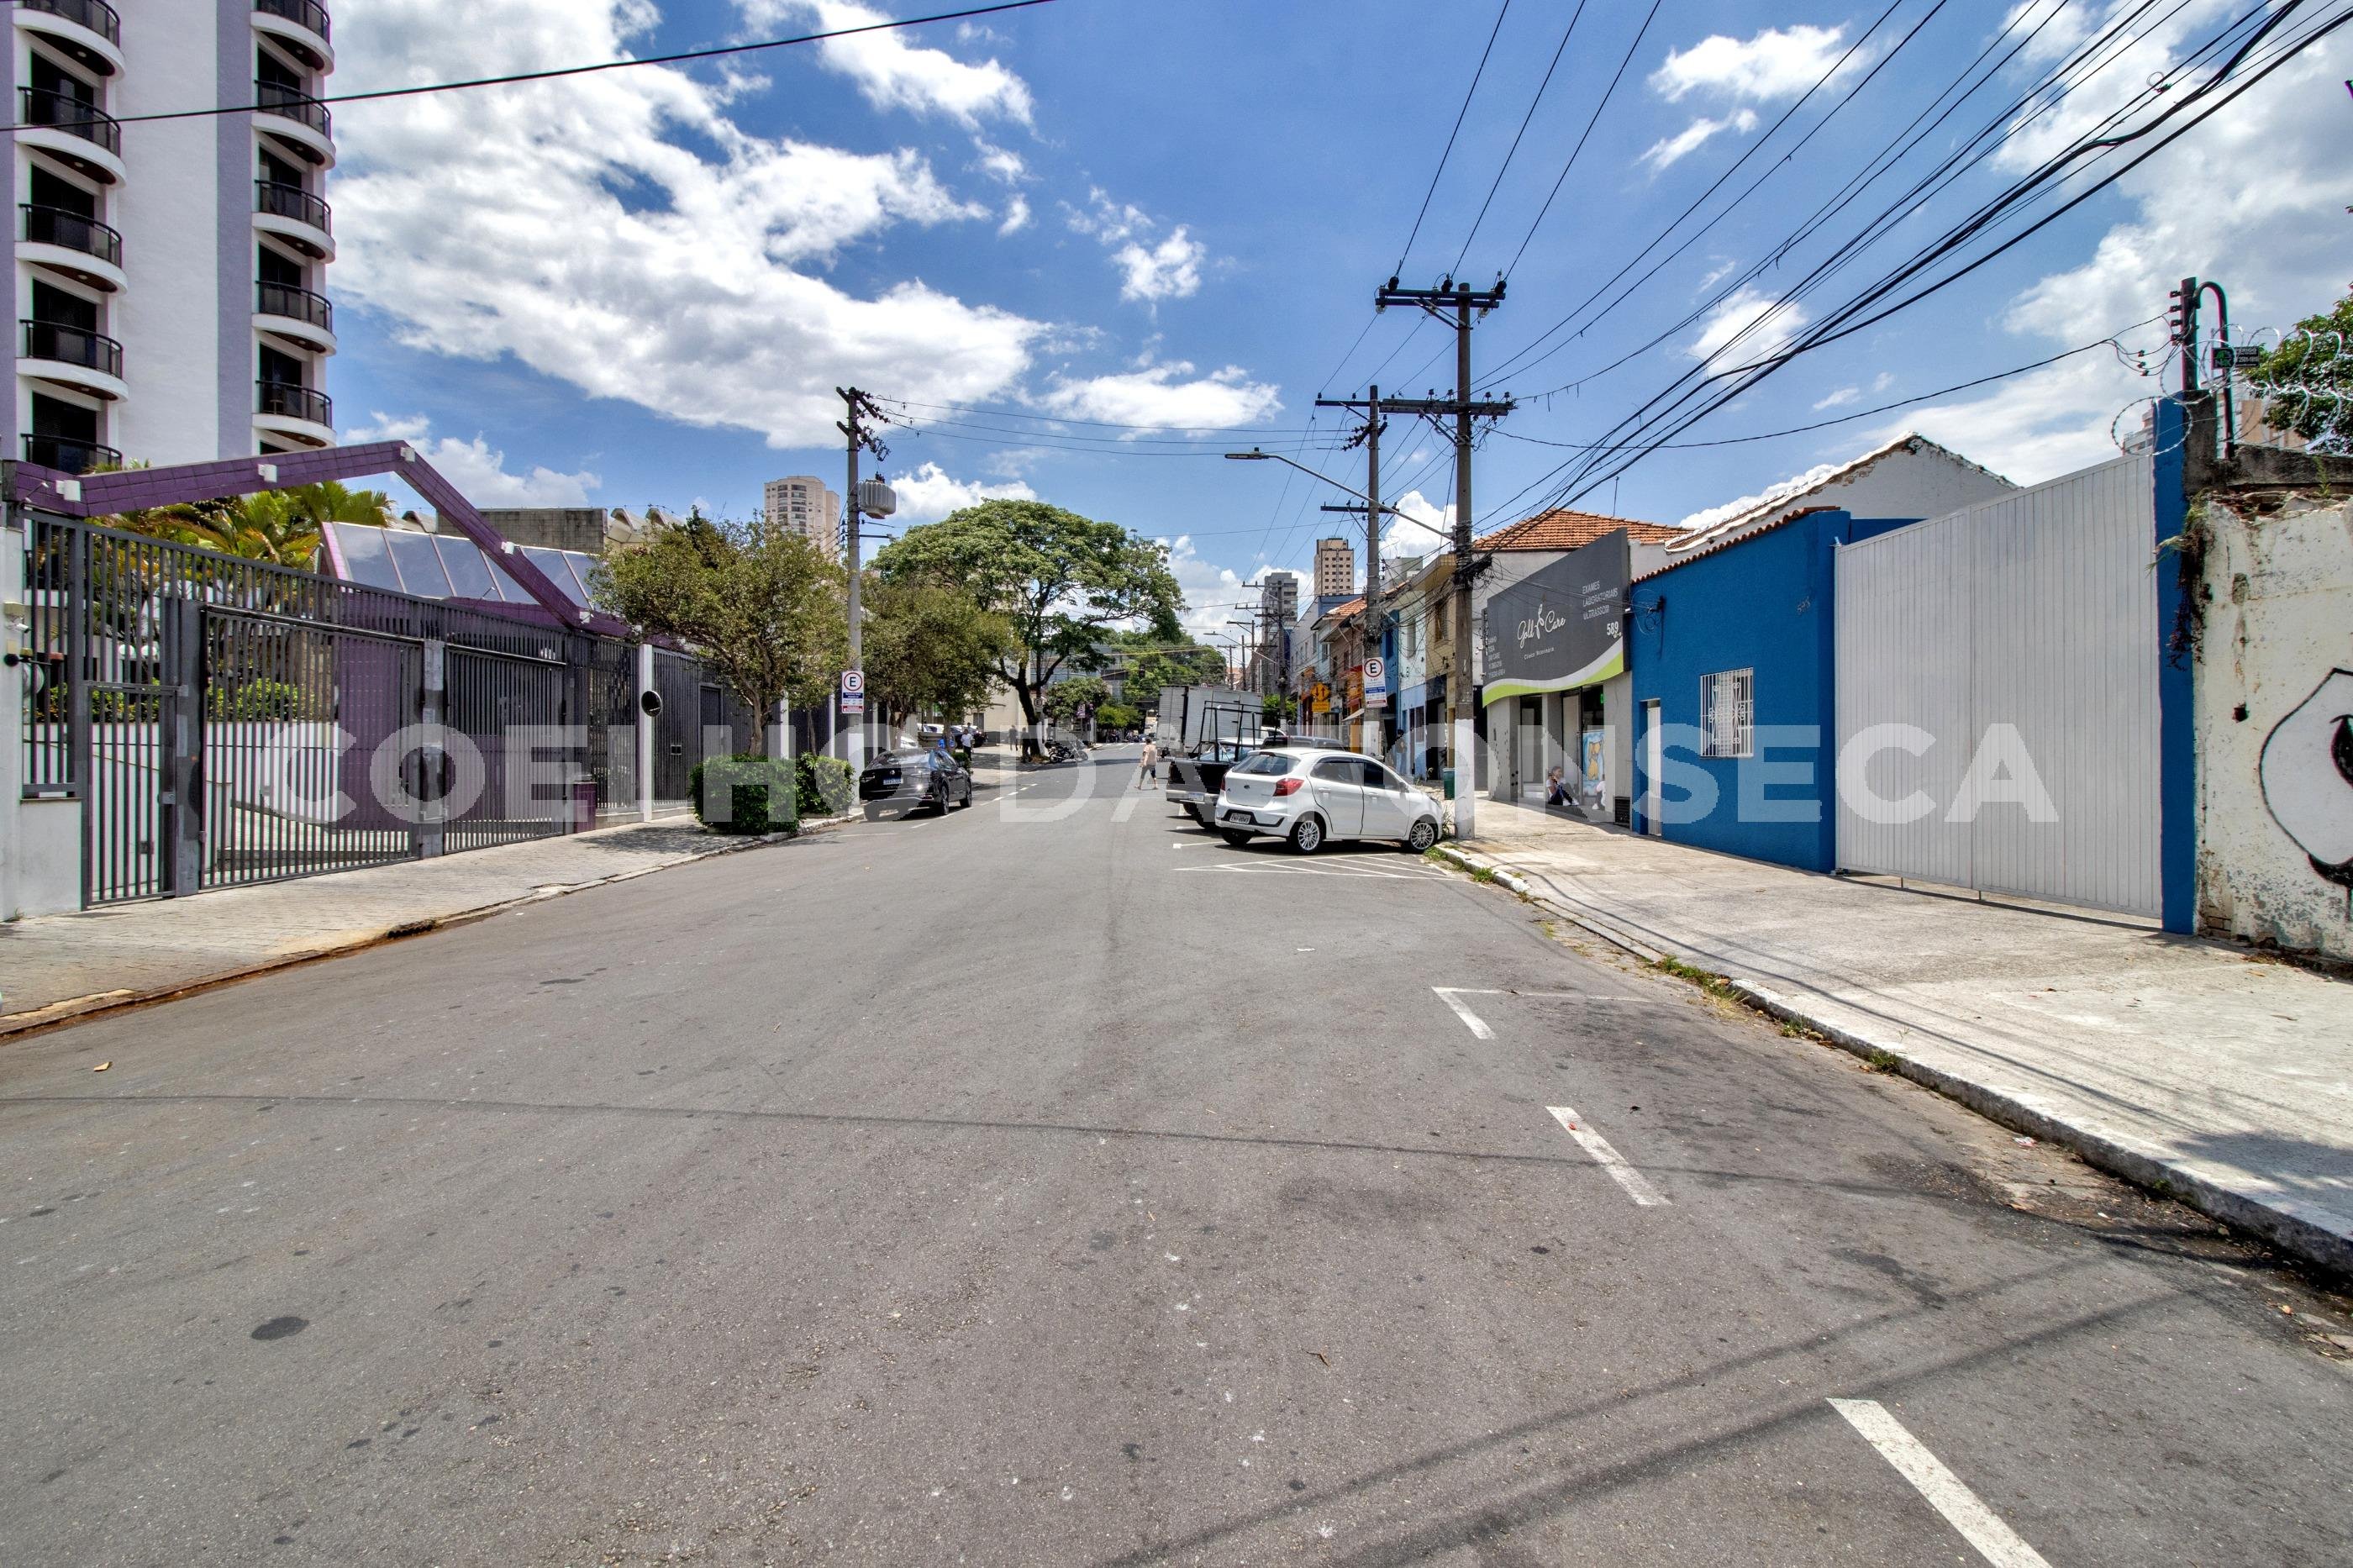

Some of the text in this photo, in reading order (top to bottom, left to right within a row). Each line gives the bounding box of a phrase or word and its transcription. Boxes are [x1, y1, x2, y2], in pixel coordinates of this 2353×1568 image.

[1582, 580, 1600, 594] EXAMES
[1583, 587, 1619, 608] LABORATORIAIS
[1583, 604, 1610, 620] ULTRASSOM
[1518, 619, 1534, 649] Gold
[1545, 610, 1566, 632] Care
[1607, 621, 1619, 636] 589
[1371, 663, 1377, 673] E
[850, 676, 856, 687] E
